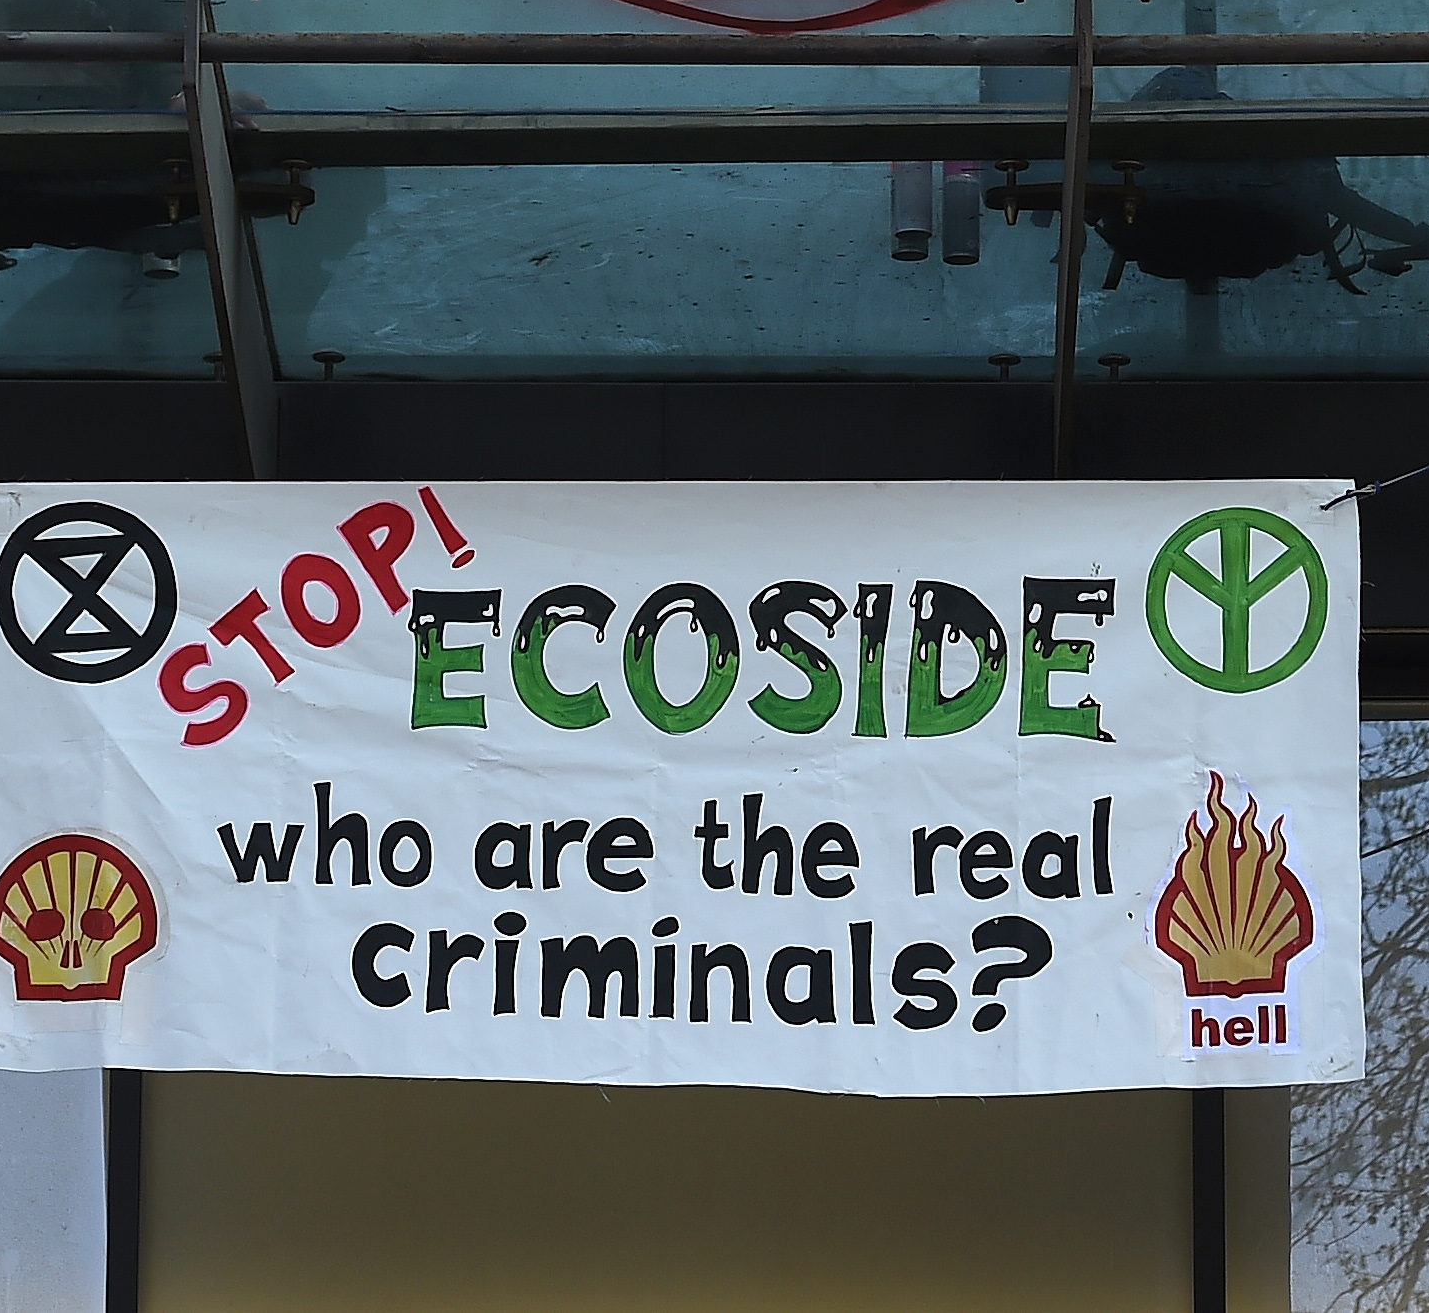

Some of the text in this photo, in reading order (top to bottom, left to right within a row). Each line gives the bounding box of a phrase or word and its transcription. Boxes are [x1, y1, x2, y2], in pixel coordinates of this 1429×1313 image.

[157, 486, 477, 748] STOP!
[408, 577, 1118, 743] ECOSIDE
[217, 781, 1114, 900] who are the real
[352, 912, 1053, 1033] criminals?
[1191, 1004, 1287, 1048] hell
